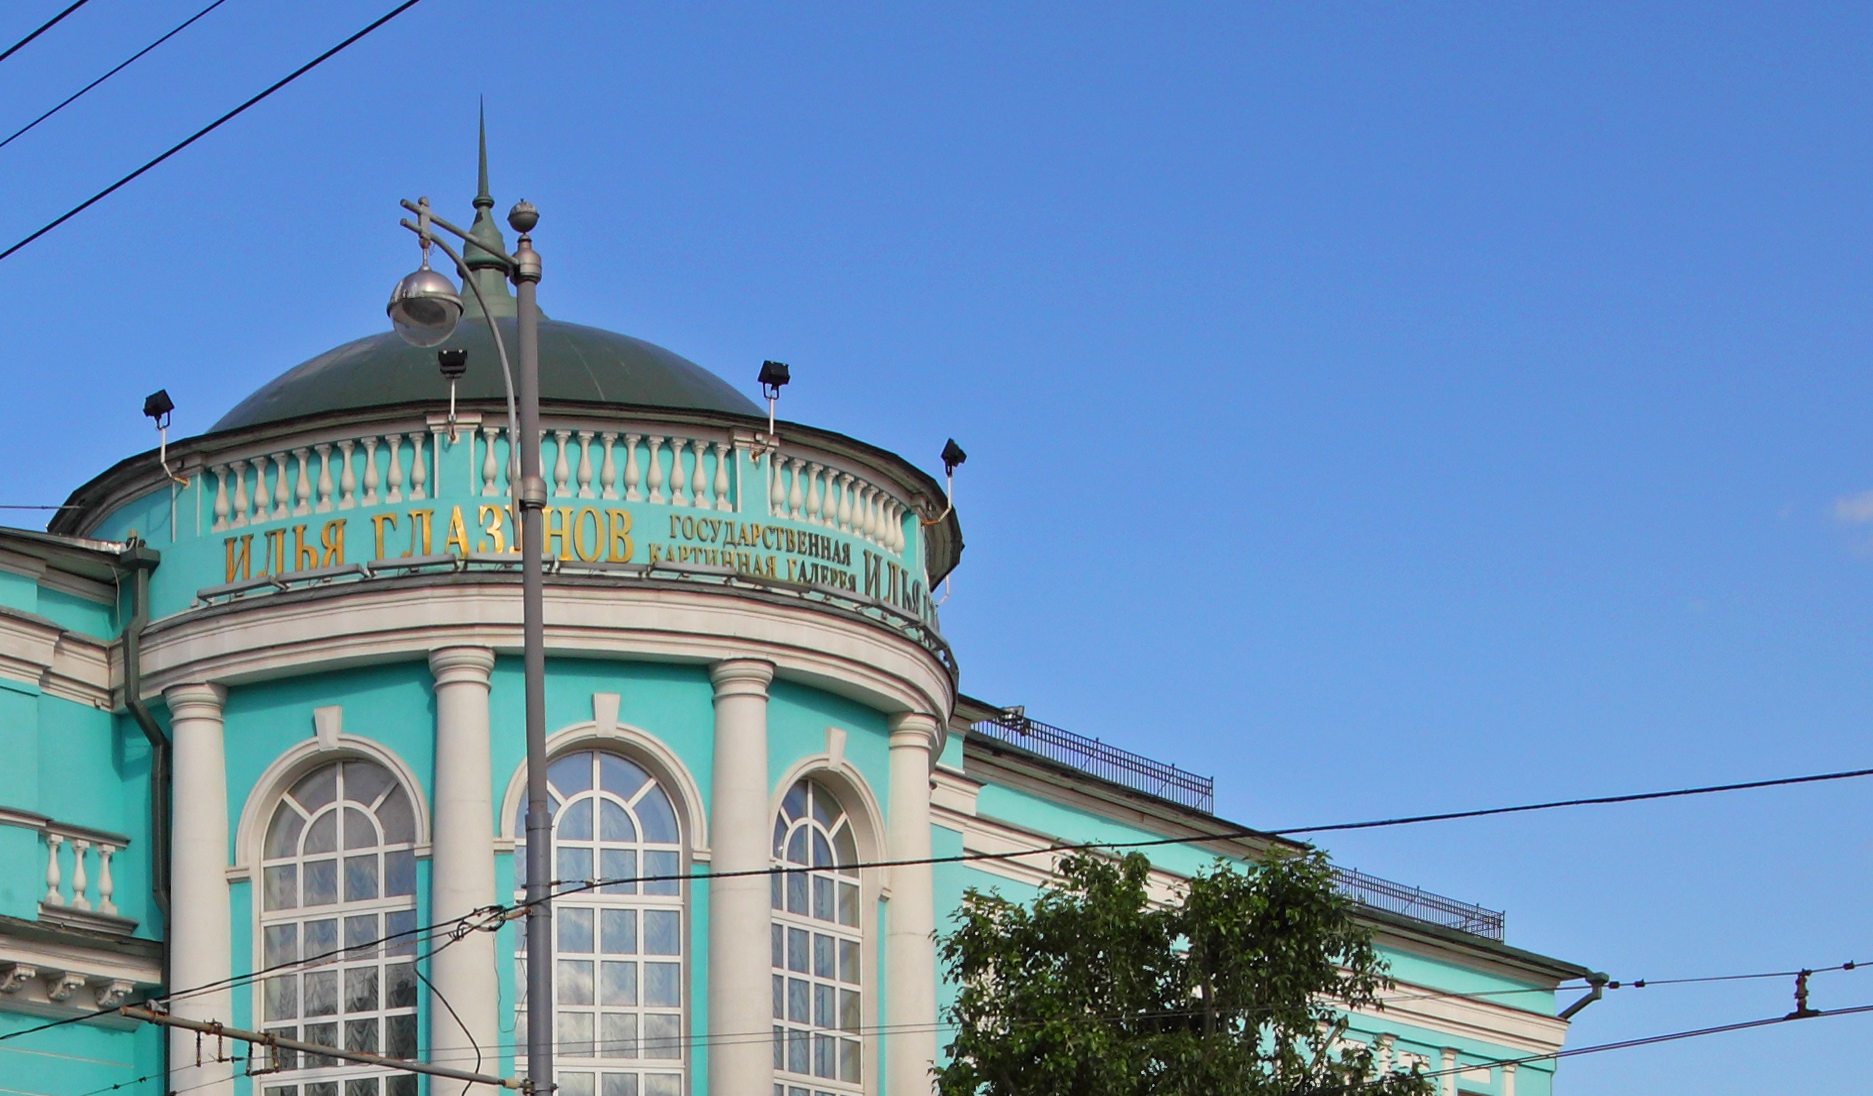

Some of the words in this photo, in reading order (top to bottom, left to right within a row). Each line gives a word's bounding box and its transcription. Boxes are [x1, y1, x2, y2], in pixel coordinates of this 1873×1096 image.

[224, 518, 347, 584] ИЛЬЯ
[670, 514, 852, 567] ГОСУДАРСТВЕННАЯ
[787, 557, 857, 592] ГАЛЕРЕЯ
[862, 548, 922, 618] ИЛЬЯ
